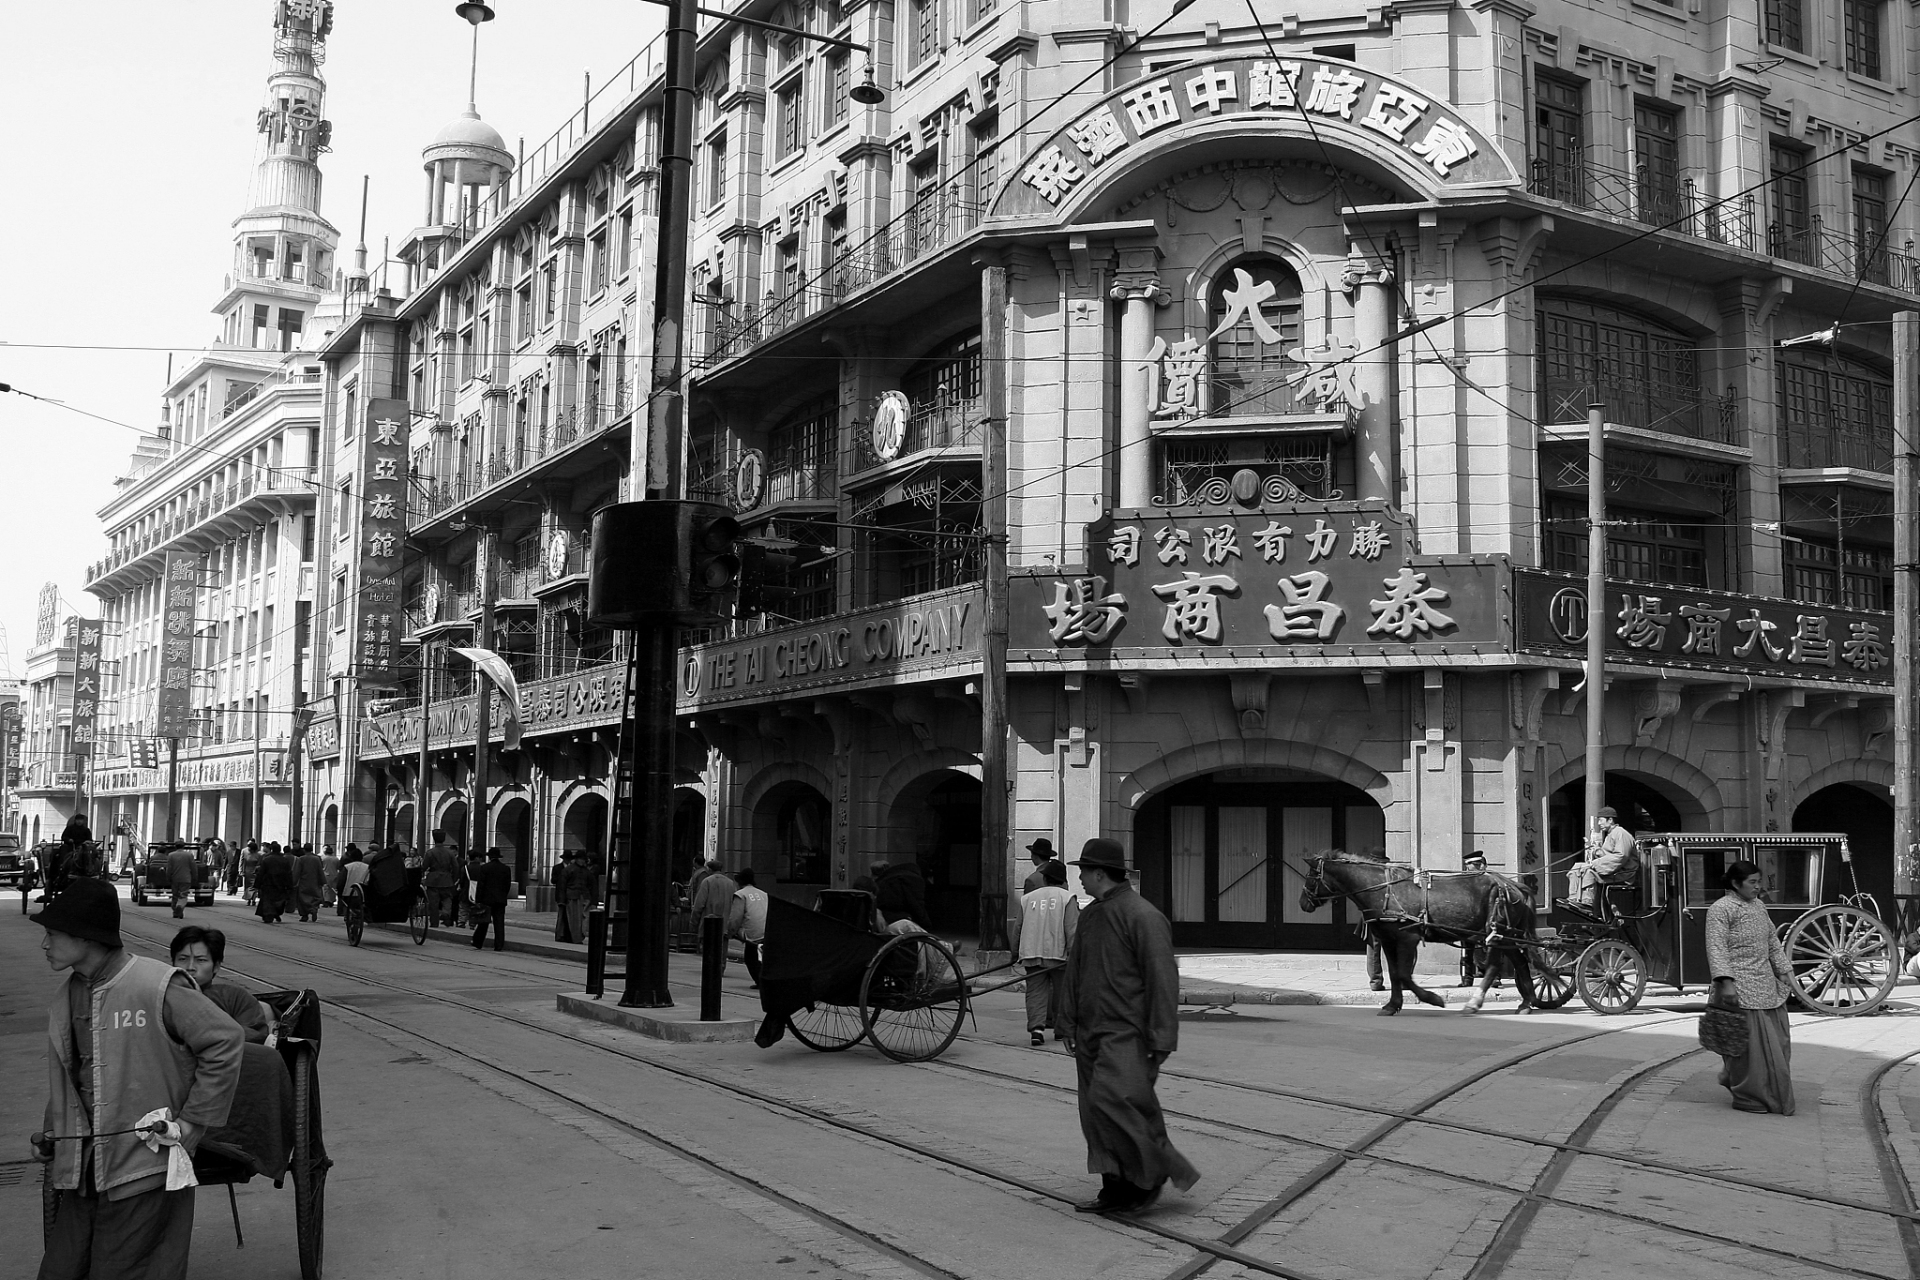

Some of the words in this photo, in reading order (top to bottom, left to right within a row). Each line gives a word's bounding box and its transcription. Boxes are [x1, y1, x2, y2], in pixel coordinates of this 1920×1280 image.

[369, 592, 394, 603] Hotel
[708, 651, 737, 689] THE
[744, 646, 766, 684] TAI
[775, 627, 850, 678] CHEONG
[863, 602, 971, 662] COMPANY
[114, 1009, 147, 1029] 126
